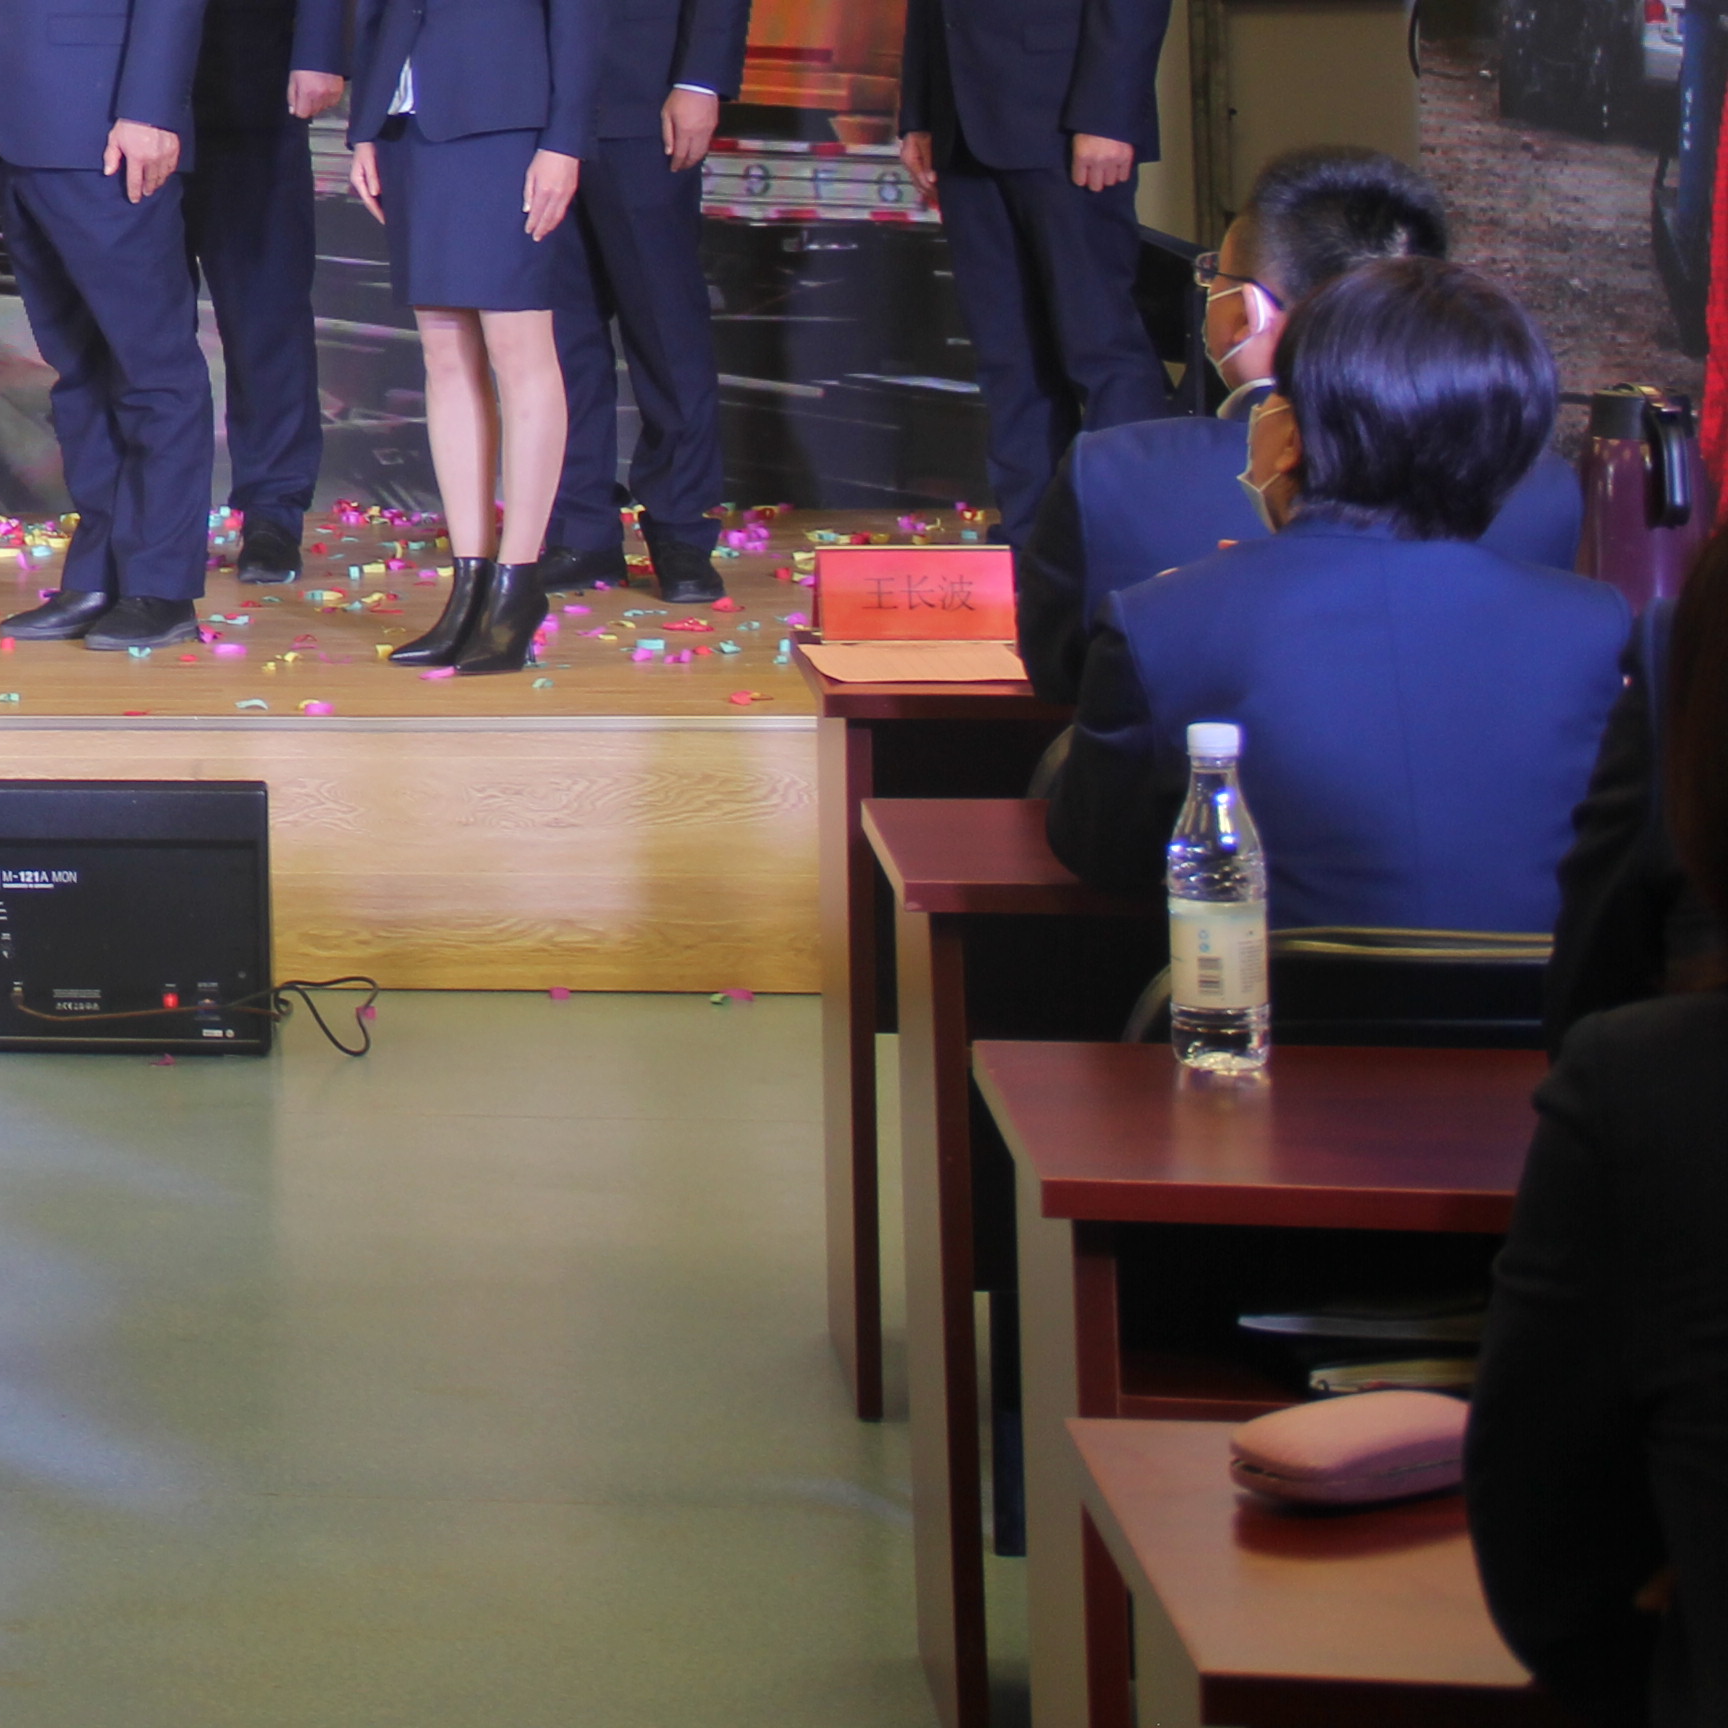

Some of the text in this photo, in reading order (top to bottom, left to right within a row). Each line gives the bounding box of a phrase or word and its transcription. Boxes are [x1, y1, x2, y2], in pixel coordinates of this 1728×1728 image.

[861, 573, 977, 612] 王长波
[1, 870, 79, 884] M-121A MON
